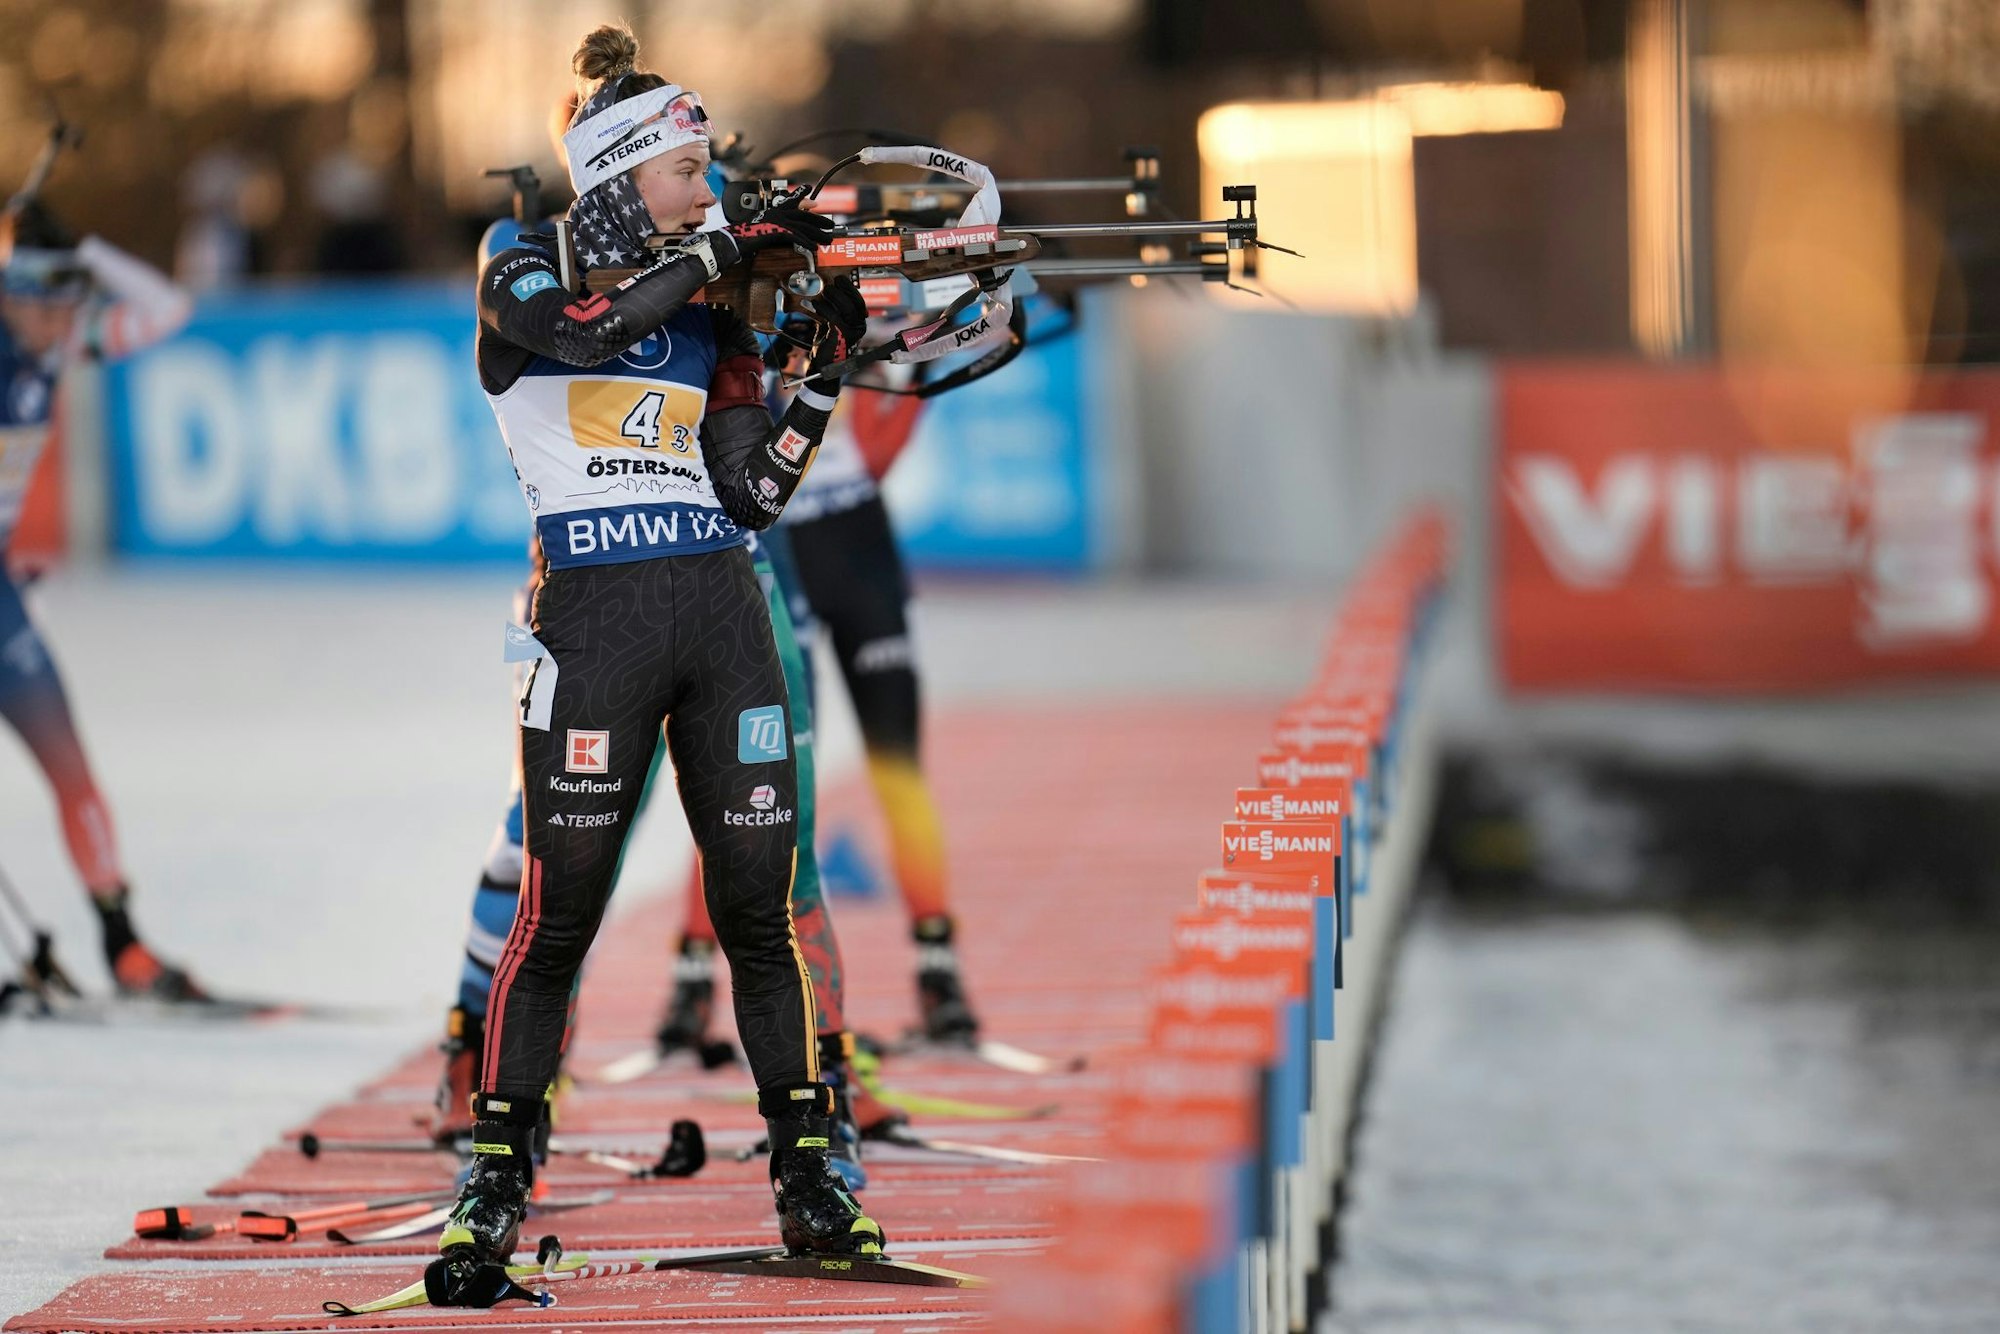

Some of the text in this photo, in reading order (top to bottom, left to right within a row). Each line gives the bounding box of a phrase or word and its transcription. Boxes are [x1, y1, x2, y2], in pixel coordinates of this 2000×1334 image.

[609, 130, 662, 162] TERREX
[926, 152, 967, 175] JOKA
[819, 240, 899, 258] VIESSMANN
[916, 232, 934, 240] DAS
[955, 318, 991, 347] JOKA
[621, 391, 666, 447] 4
[671, 425, 689, 453] 3
[765, 441, 804, 476] Kaufland
[567, 511, 678, 555] BMW
[549, 776, 622, 793] Kaufland
[566, 811, 620, 827] TERREX
[723, 806, 792, 826] tectake
[1239, 795, 1339, 820] VIESSMANN
[1225, 830, 1331, 860] VIESSMANN
